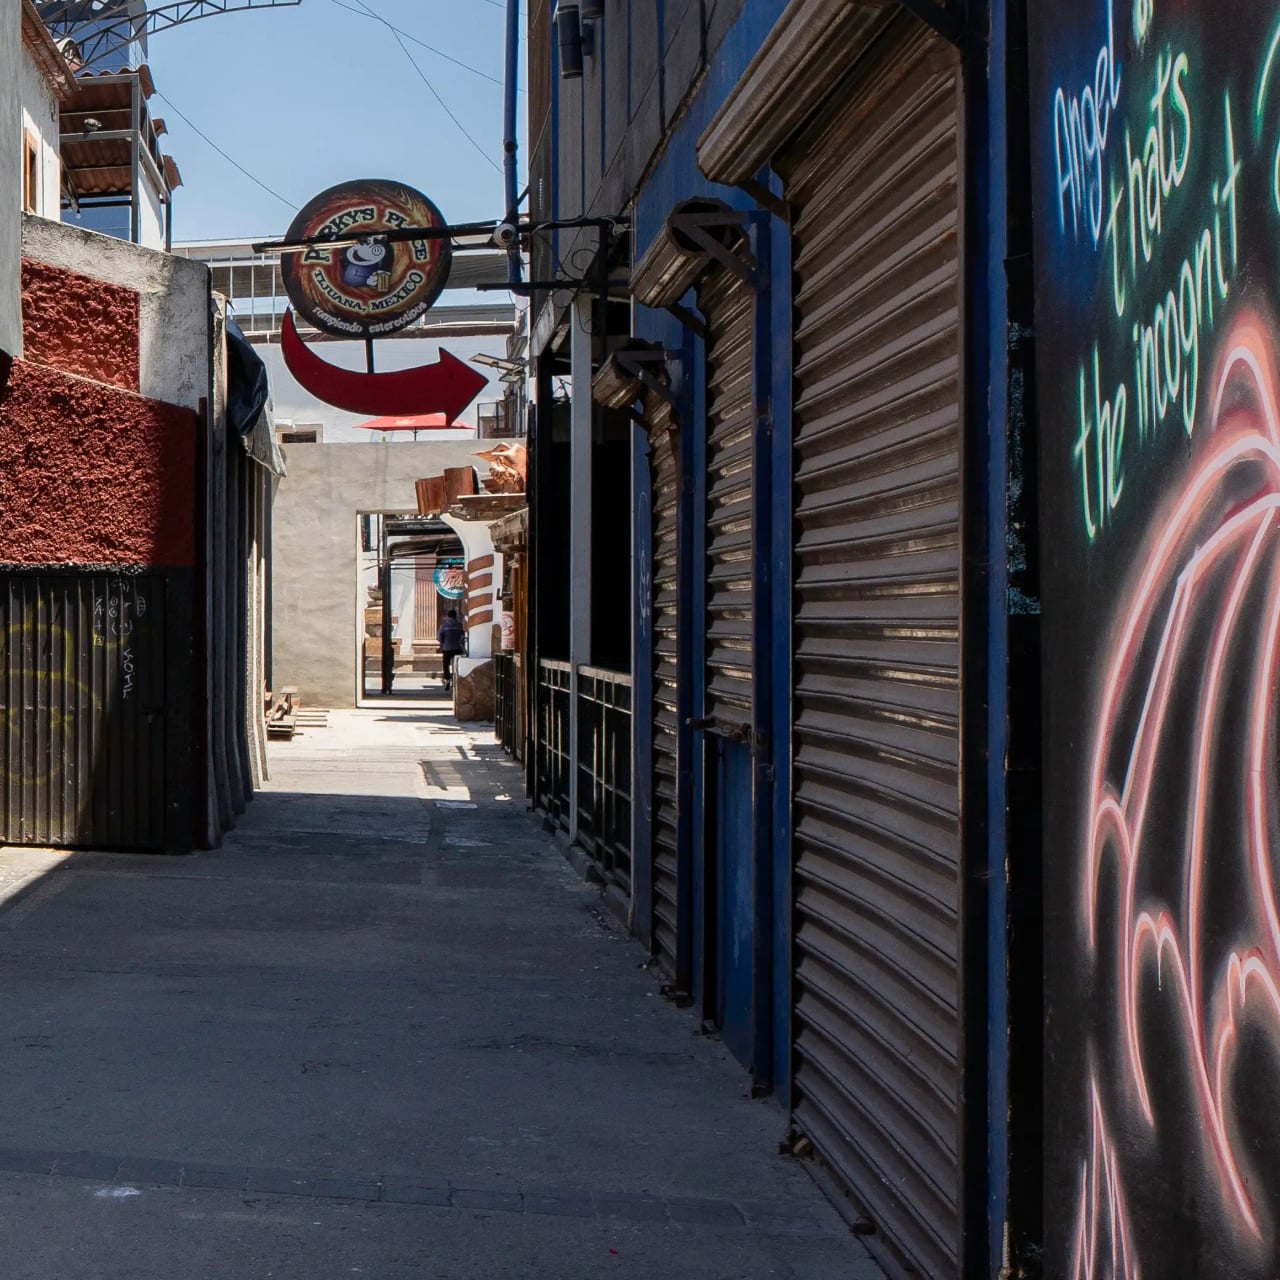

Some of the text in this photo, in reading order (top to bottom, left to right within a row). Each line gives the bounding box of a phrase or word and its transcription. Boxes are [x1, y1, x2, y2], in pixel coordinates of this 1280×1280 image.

[384, 209, 429, 262] PLCE
[370, 271, 424, 312] MEXICO
[1073, 339, 1128, 542] the
